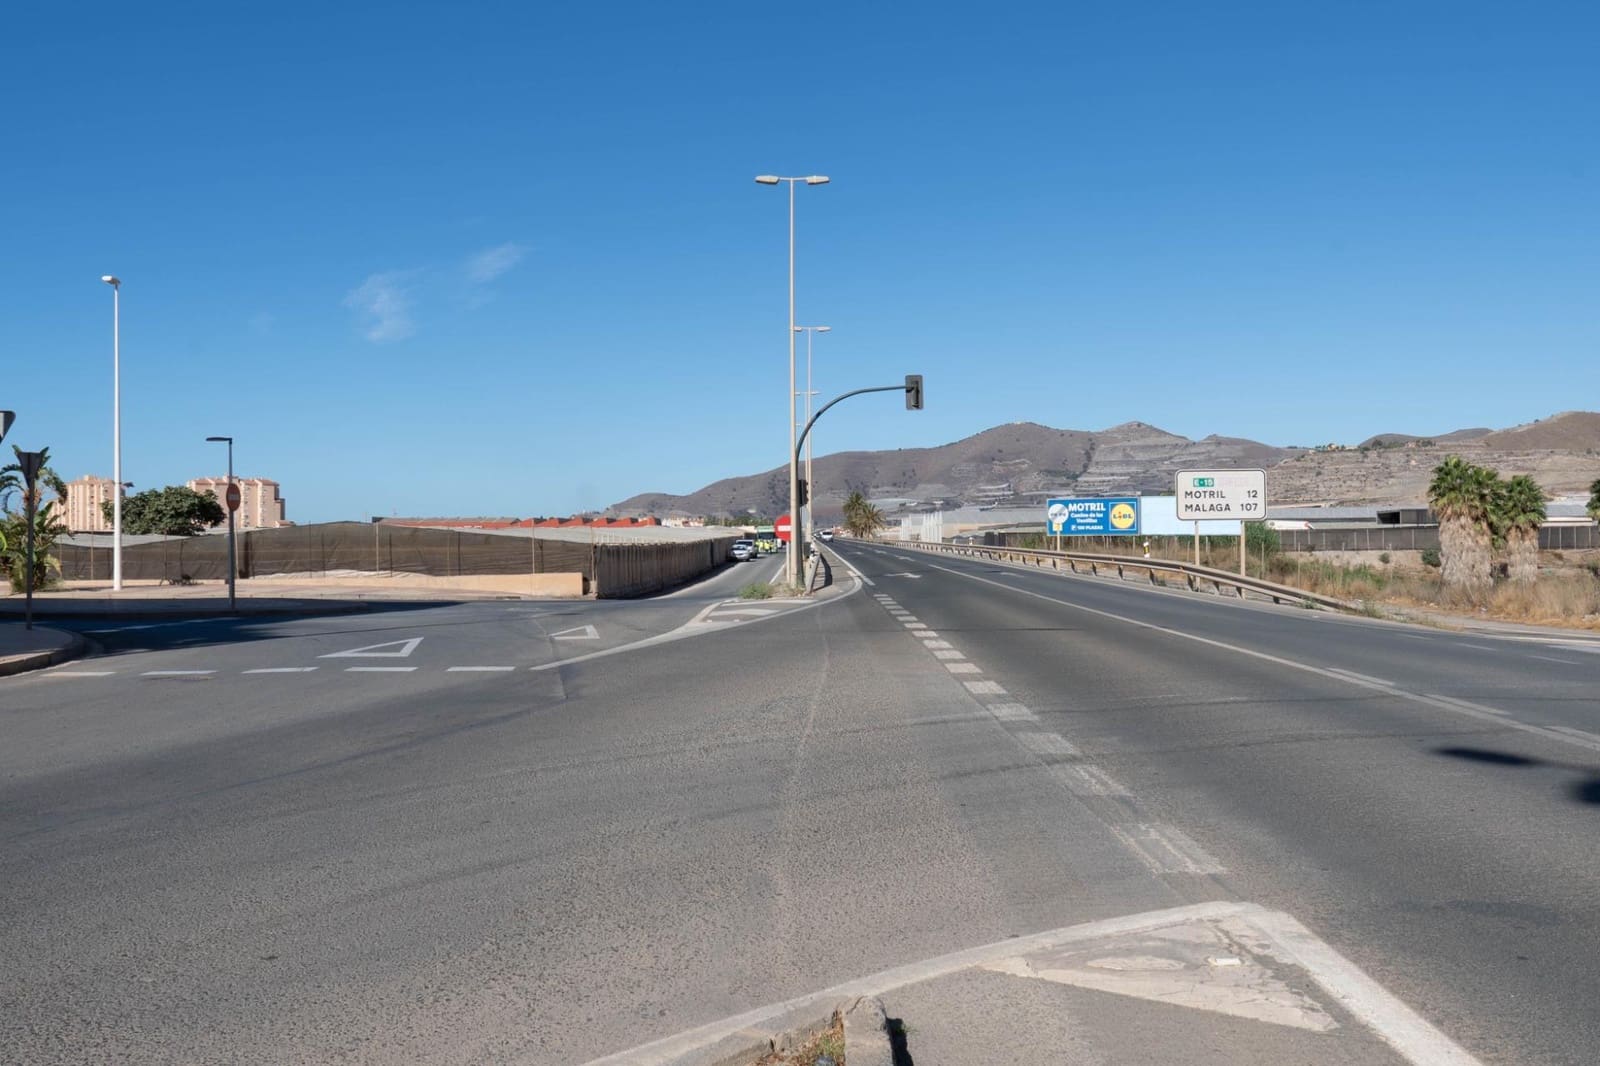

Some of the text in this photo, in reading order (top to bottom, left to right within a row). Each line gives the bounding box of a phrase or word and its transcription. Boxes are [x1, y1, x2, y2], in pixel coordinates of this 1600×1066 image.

[1184, 490, 1258, 499] MOTRIL 12
[1068, 503, 1106, 512] MOTRIL
[1184, 503, 1258, 512] MALAGA 107
